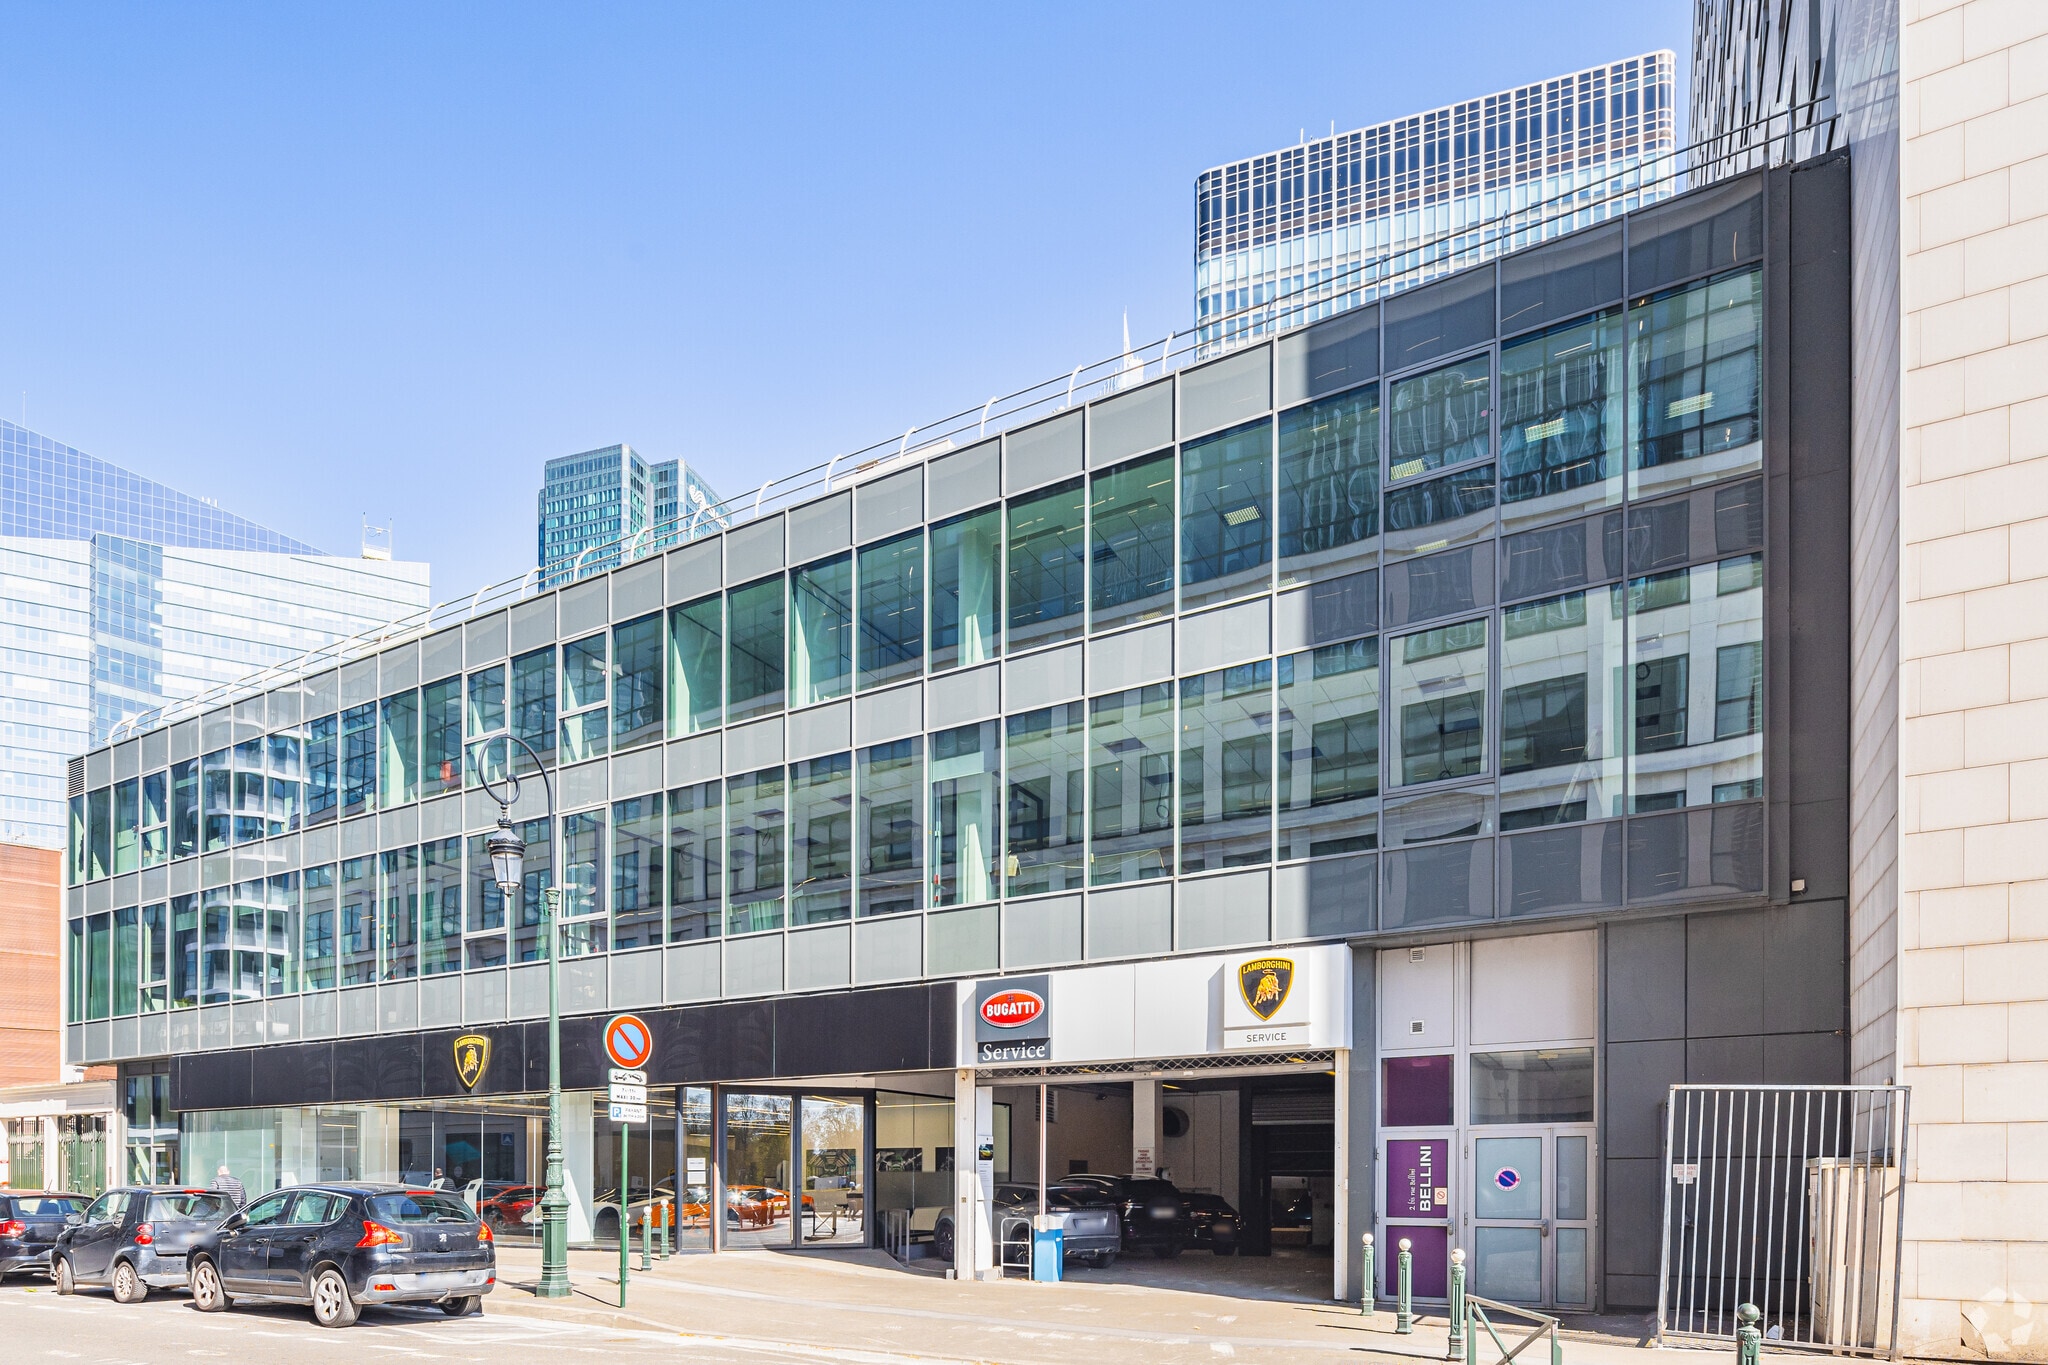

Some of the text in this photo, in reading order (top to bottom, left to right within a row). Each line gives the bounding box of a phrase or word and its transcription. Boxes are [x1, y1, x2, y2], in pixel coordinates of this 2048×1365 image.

[1243, 960, 1291, 974] LAMBORGHINI
[986, 1001, 1035, 1017] BUGATTI
[1246, 1032, 1287, 1042] SERVICE
[982, 1041, 1046, 1061] Service
[1420, 1146, 1432, 1211] BELLINI
